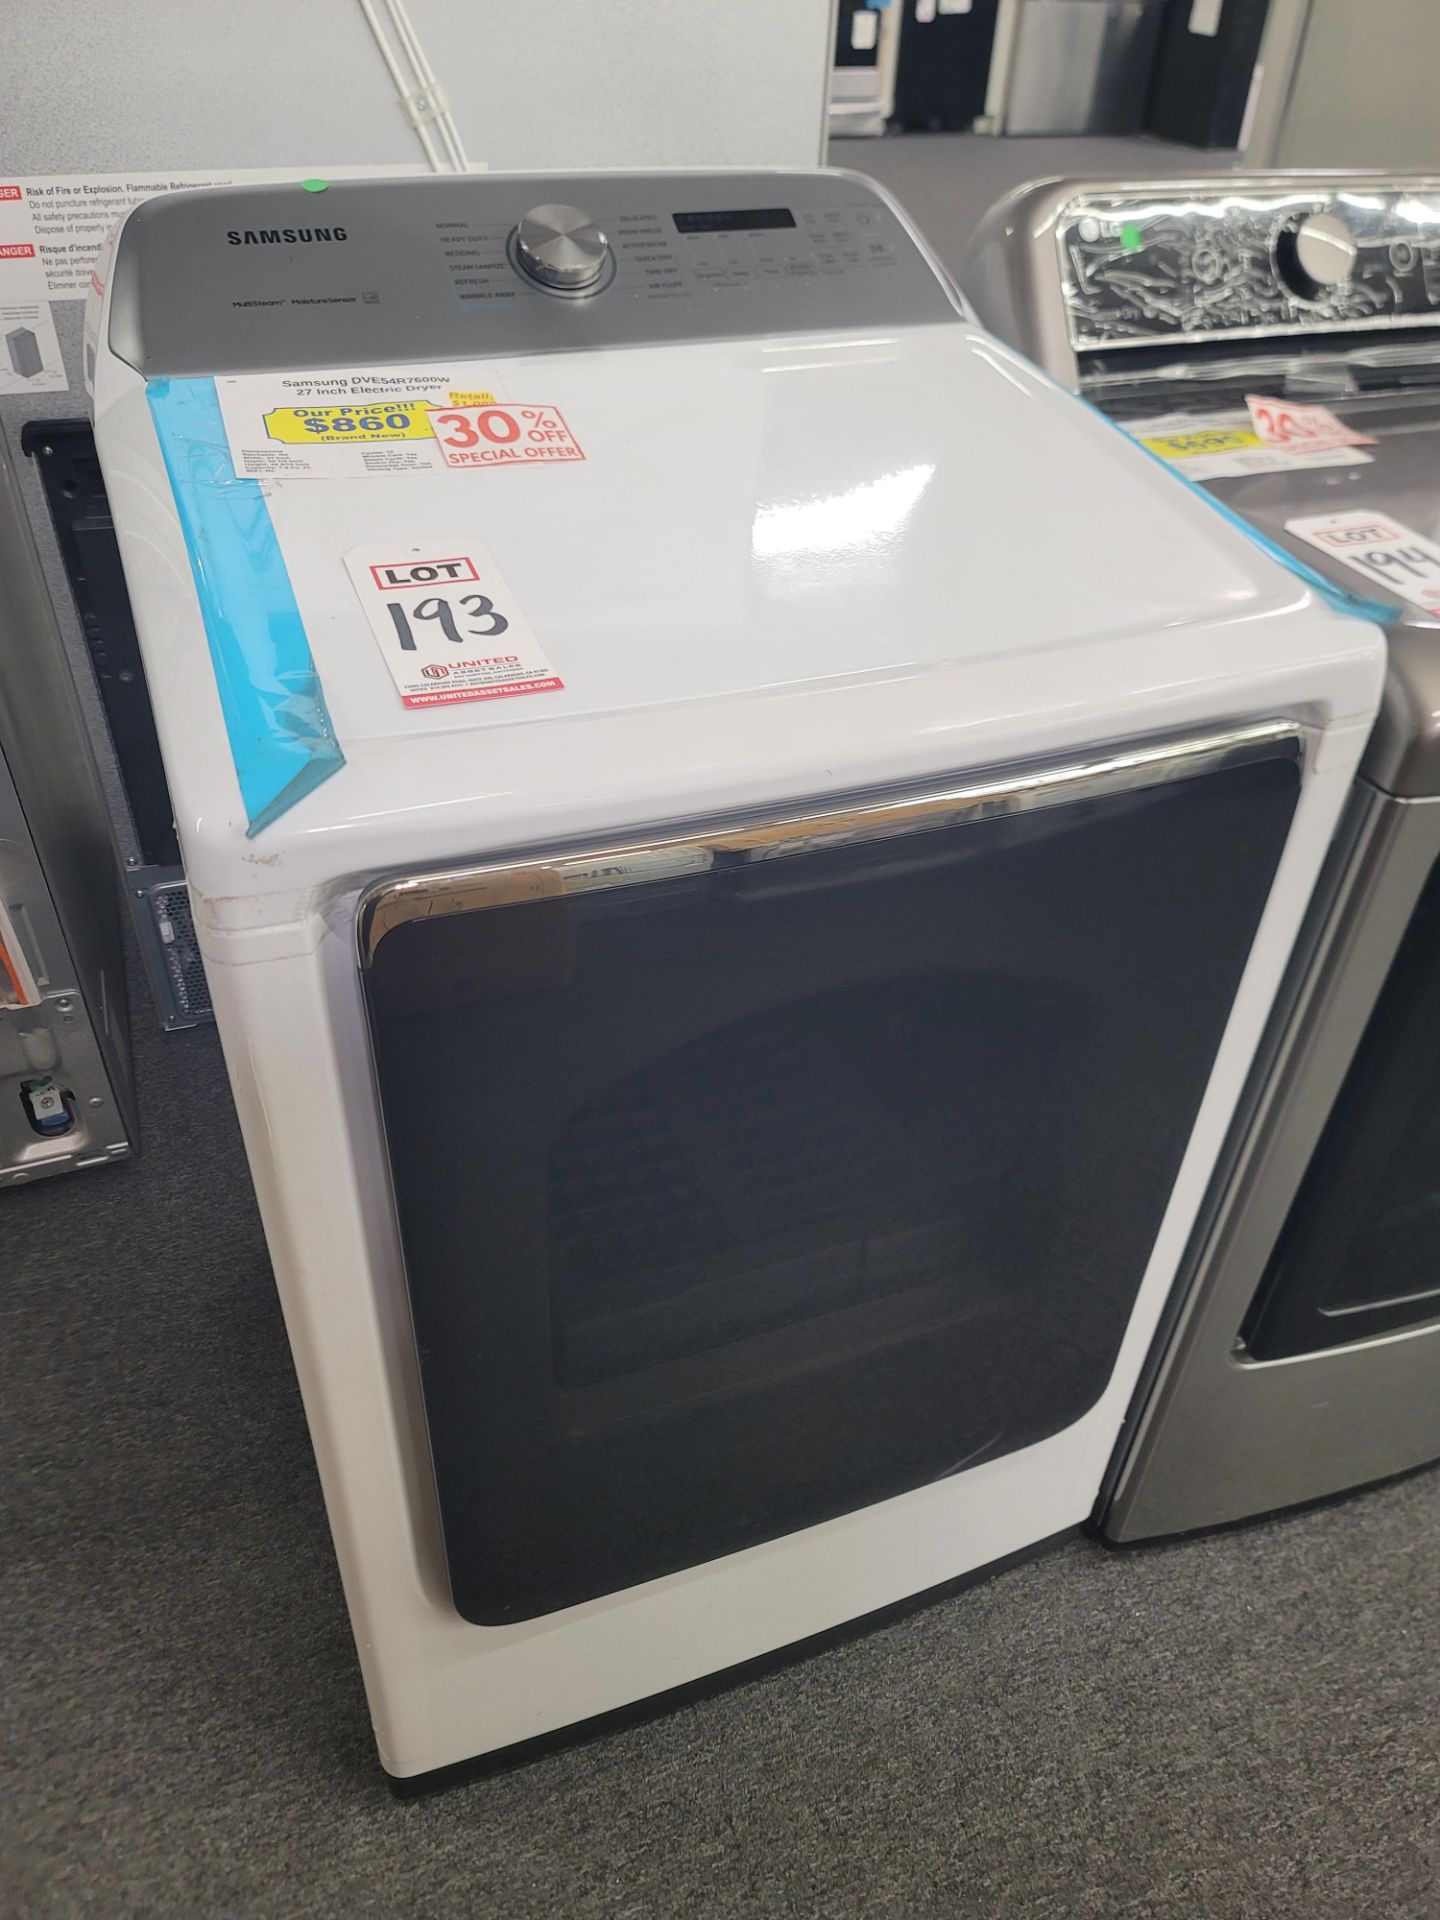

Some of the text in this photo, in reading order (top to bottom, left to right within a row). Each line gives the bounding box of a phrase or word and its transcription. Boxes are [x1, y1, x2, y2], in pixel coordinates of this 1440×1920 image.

[26, 187, 45, 196] Risk
[46, 187, 54, 195] of
[56, 186, 71, 195] Fire
[83, 184, 124, 195] Explosion.
[126, 183, 168, 193] Flammable
[29, 200, 40, 209] Do
[42, 200, 54, 208] not
[56, 199, 87, 209] puncture
[89, 197, 127, 208] refrigerant
[43, 212, 65, 221] safety
[67, 210, 109, 220] precautions
[34, 225, 64, 235] Dispose
[76, 224, 104, 234] properly
[227, 227, 347, 245] SAMSUNG
[40, 244, 66, 255] Risque
[42, 258, 53, 266] Ne
[55, 258, 67, 266] pas
[282, 380, 348, 388] Samsung
[296, 388, 312, 396] 27
[351, 386, 402, 394] Electric
[293, 403, 415, 418] Our Price!!!
[304, 413, 411, 435] $860
[437, 410, 521, 449] 30
[527, 430, 568, 443] OFF
[449, 447, 578, 464] SPECIAL OFFER
[1326, 529, 1381, 543] LOT
[1346, 547, 1440, 585] 194
[385, 563, 462, 585] LOT
[387, 594, 509, 651] 193
[448, 655, 518, 669] UNITED
[409, 680, 557, 704] WWW.UNITEDASSETSALES.COM
